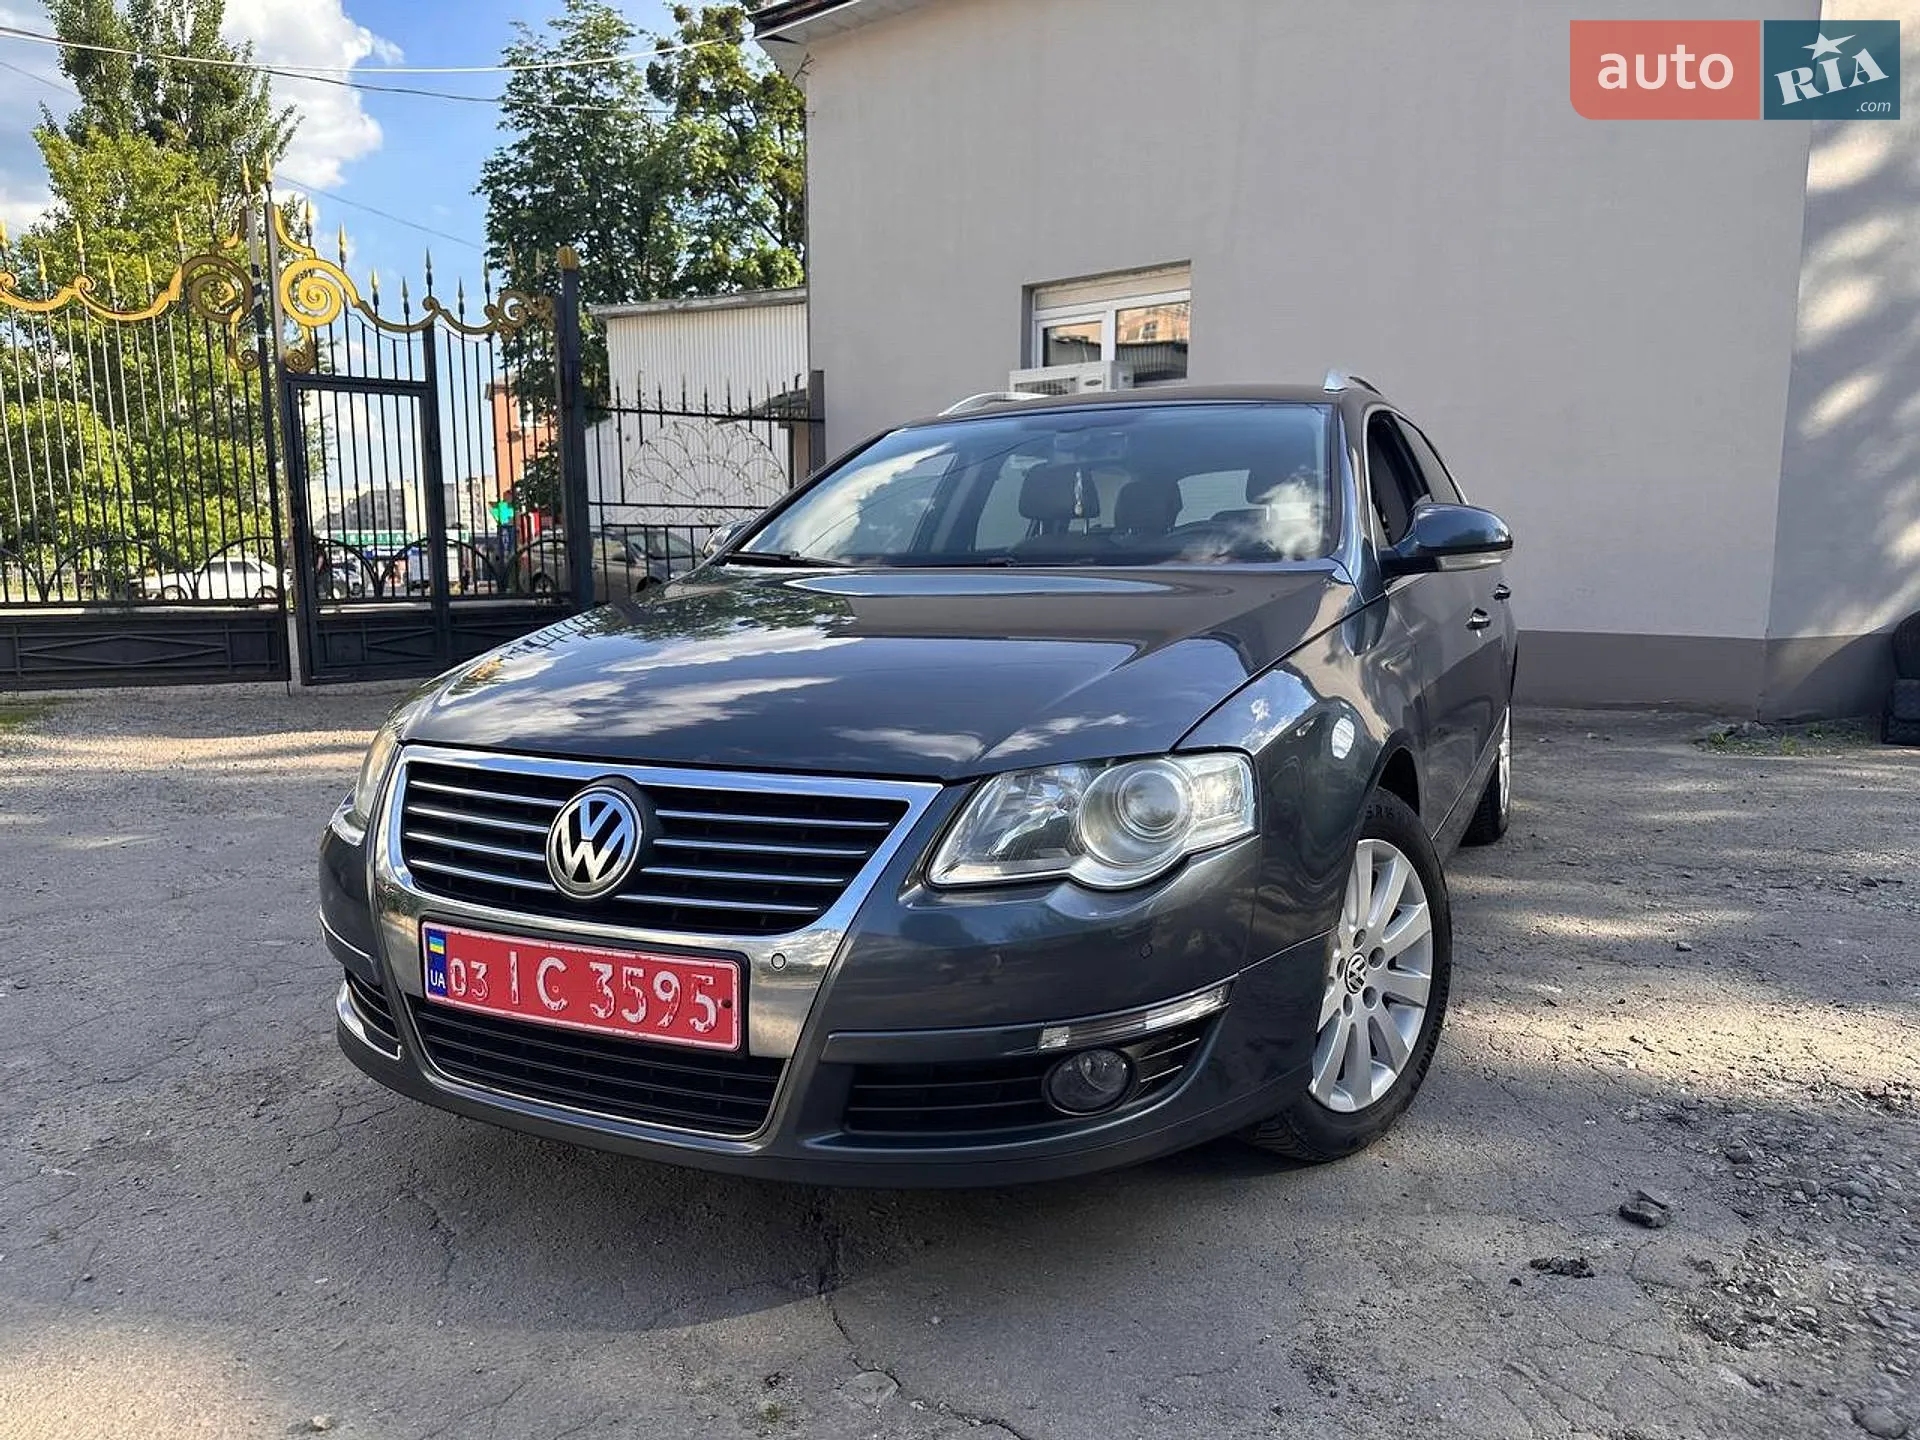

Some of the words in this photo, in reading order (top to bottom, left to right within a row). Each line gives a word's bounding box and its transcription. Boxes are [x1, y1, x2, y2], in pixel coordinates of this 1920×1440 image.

[430, 969, 446, 989] UA
[450, 957, 488, 1001] 03
[589, 961, 719, 1034] 3595
